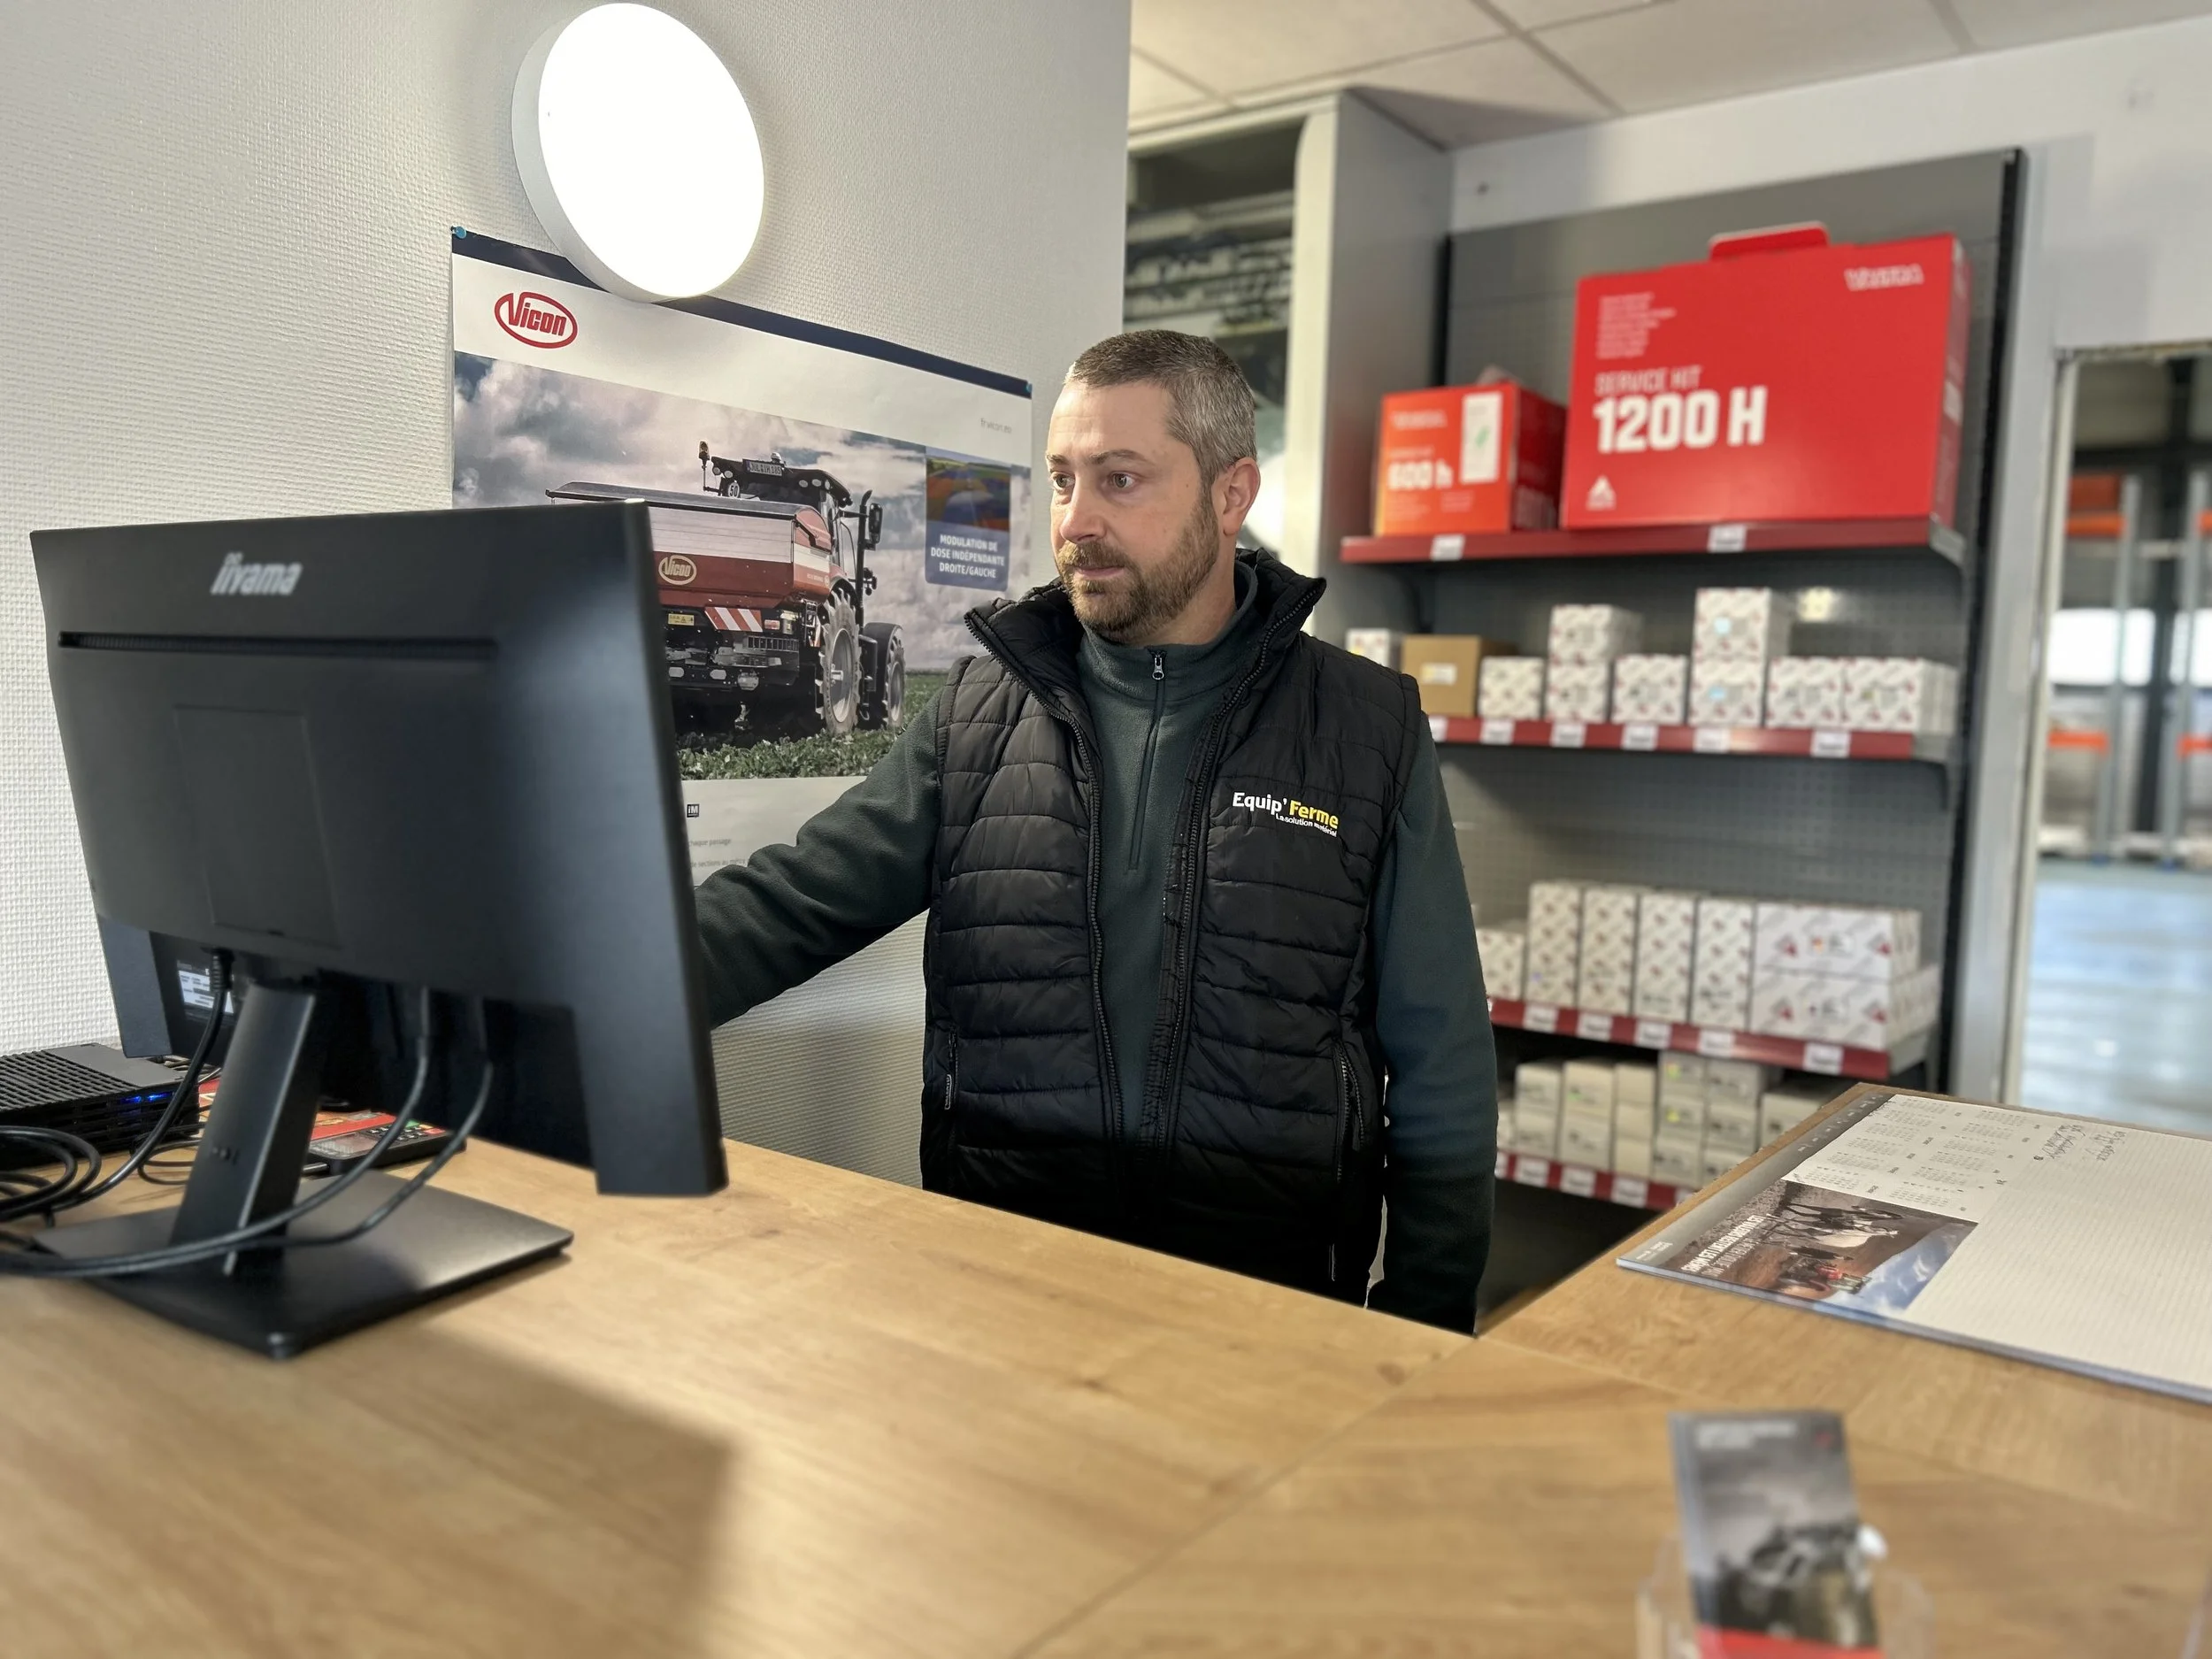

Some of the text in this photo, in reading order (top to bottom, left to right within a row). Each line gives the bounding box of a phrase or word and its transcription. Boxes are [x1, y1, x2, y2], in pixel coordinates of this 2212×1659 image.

[507, 292, 569, 337] Vicon
[1593, 385, 1768, 454] 1200 H
[729, 486, 738, 497] 50
[940, 534, 998, 552] MODULATION DE
[931, 546, 1005, 566] DOSE INDÉPENDANTE
[663, 556, 693, 579] Vicon
[940, 562, 996, 579] DROITE/GAUCHE
[1233, 792, 1340, 829] Equip' Ferme
[1285, 817, 1313, 827] solution
